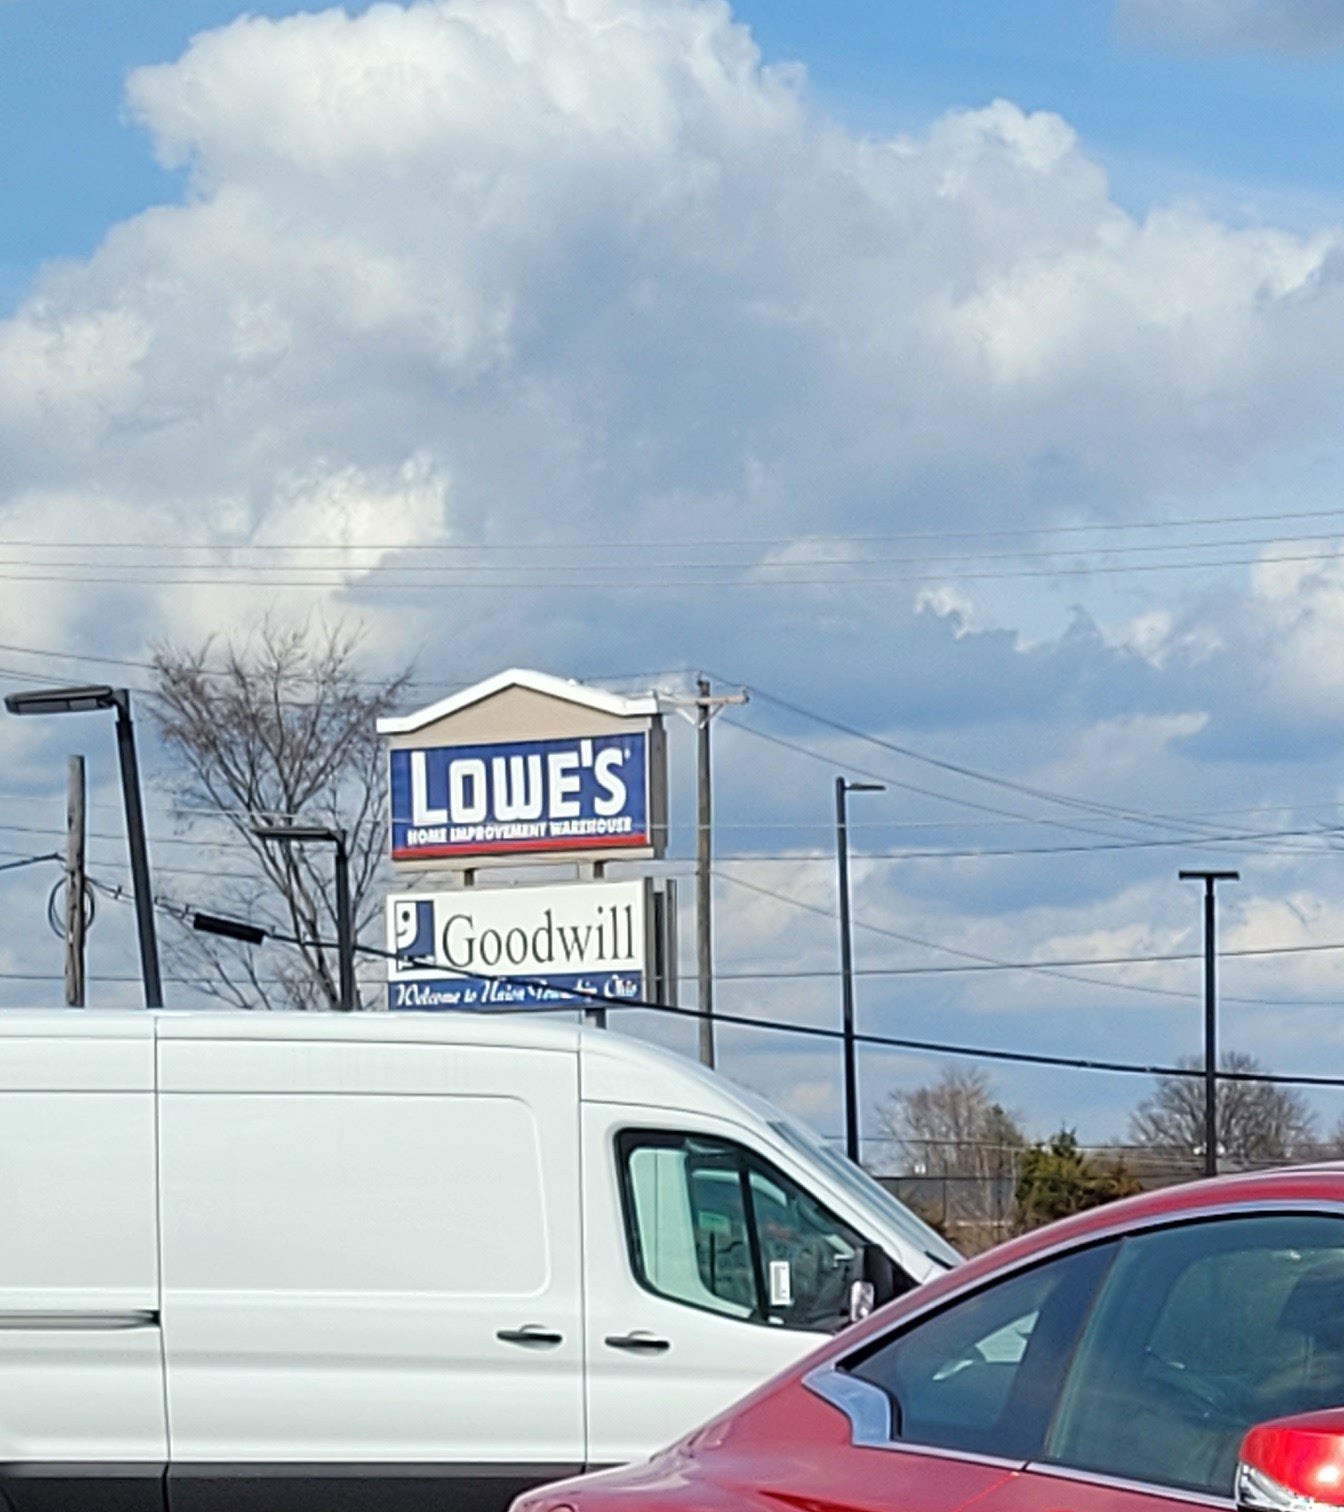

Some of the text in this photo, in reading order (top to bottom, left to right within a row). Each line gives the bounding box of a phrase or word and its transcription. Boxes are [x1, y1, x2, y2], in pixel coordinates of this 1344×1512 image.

[410, 739, 630, 826] LOWE'S
[407, 816, 632, 846] HOME IMPROVEMENT WAREHOUSE
[442, 905, 636, 967] Goodwill
